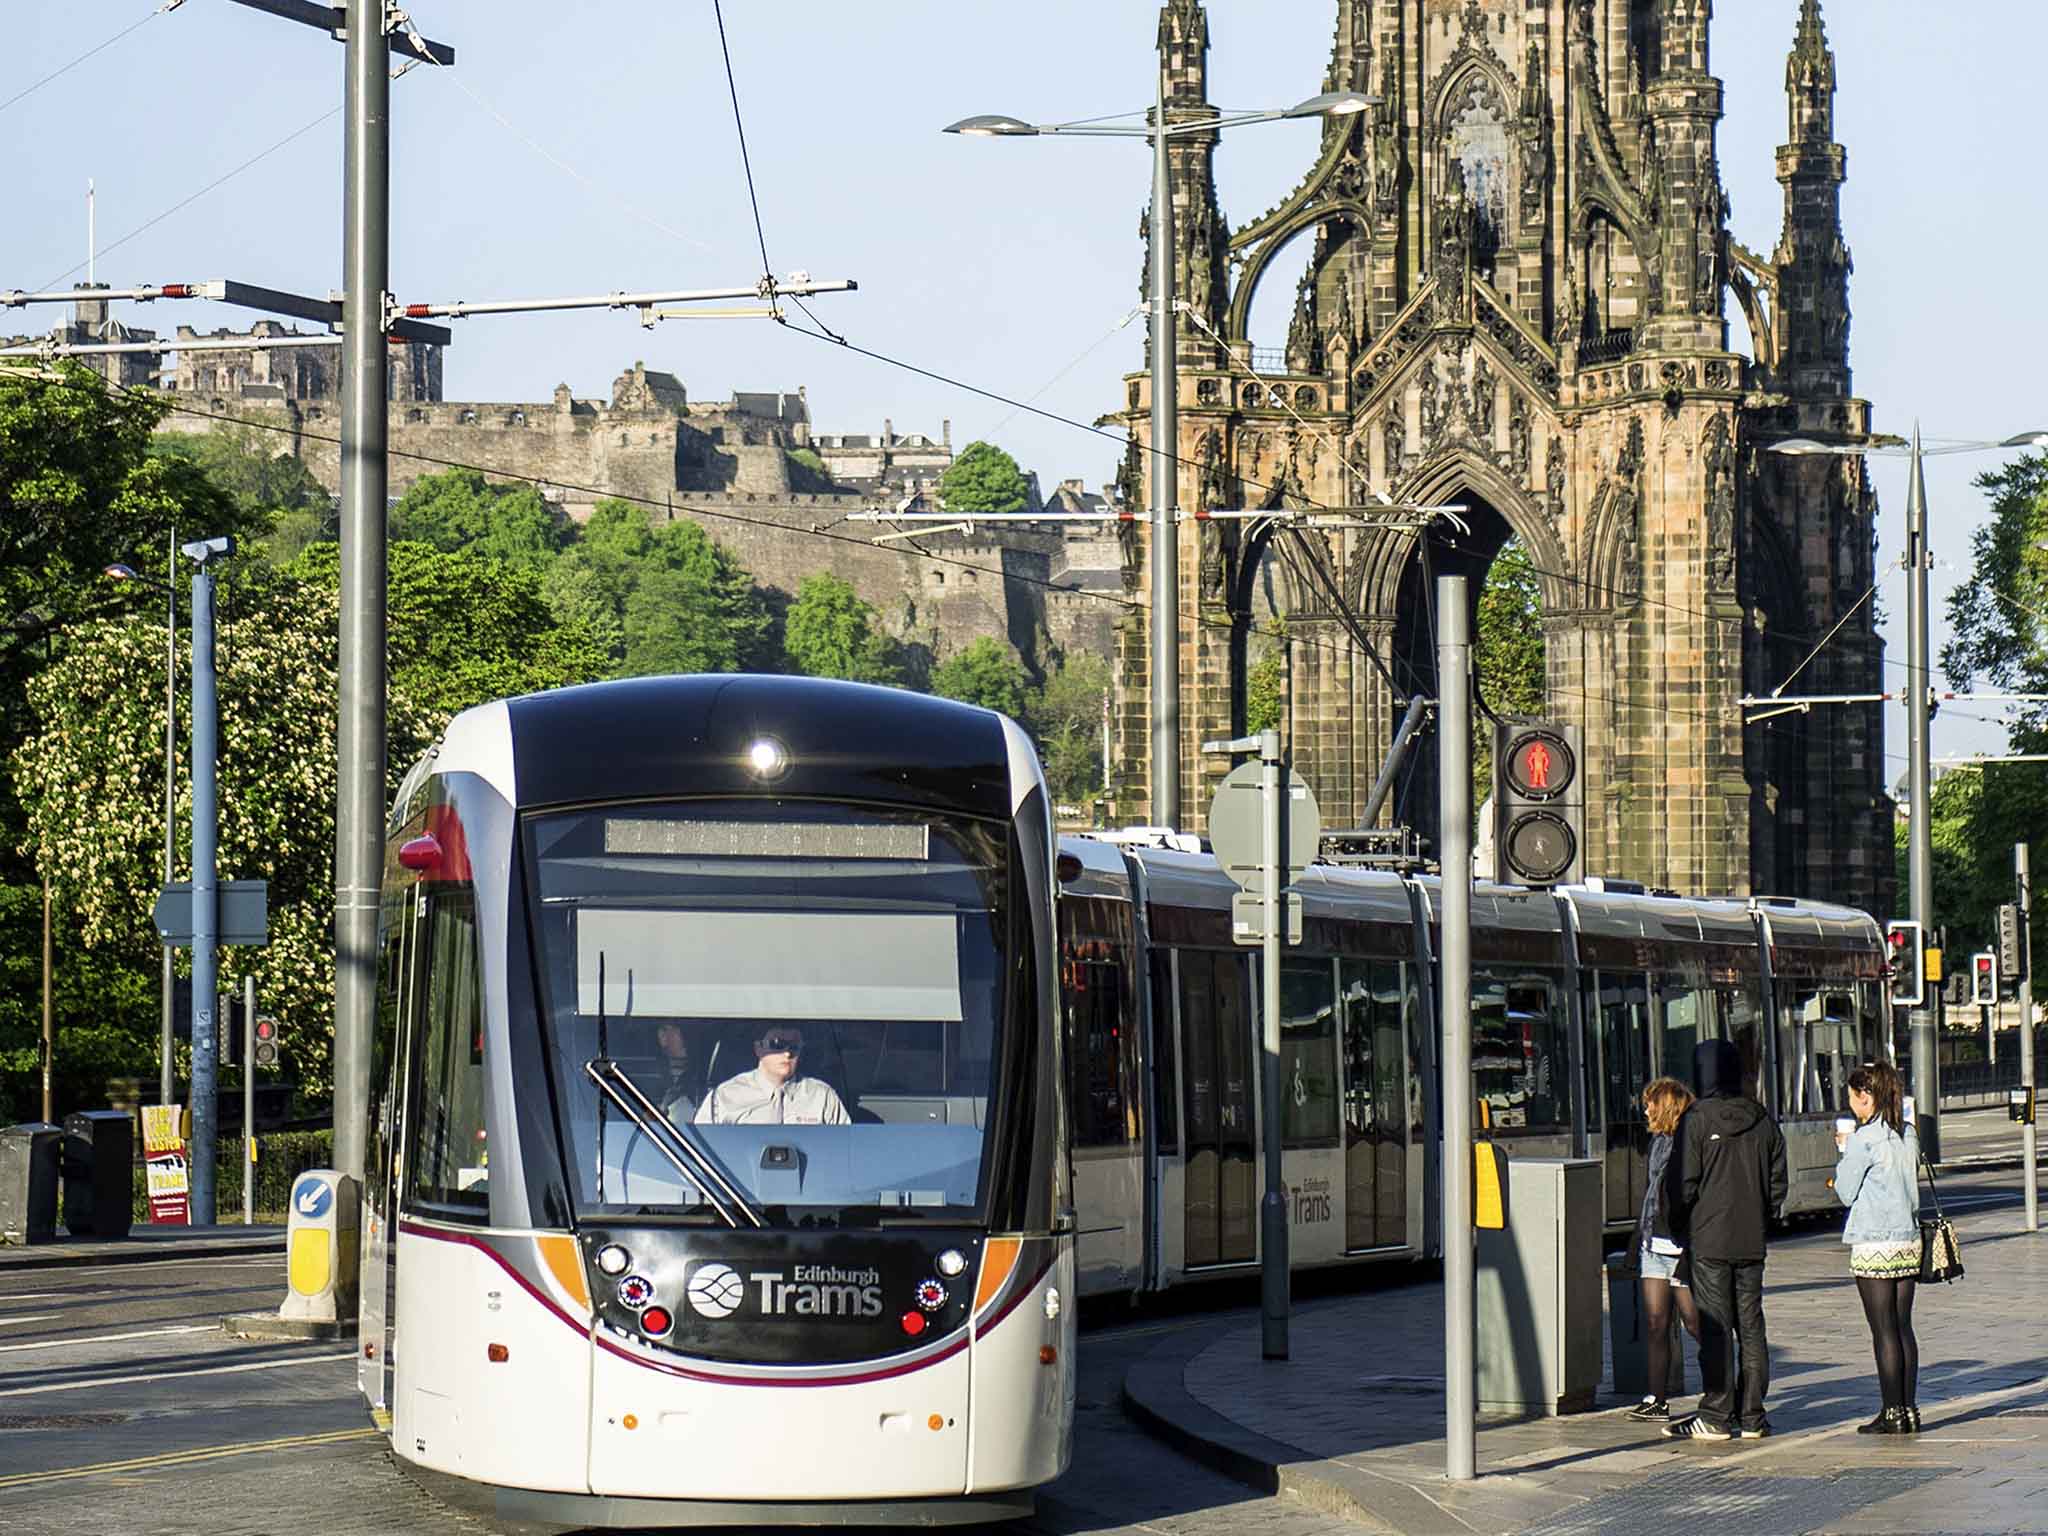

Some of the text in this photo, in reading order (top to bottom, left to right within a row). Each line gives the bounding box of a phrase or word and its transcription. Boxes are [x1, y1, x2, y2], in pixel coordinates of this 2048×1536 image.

[1291, 1186, 1330, 1225] Trams
[750, 1272, 882, 1316] Trams
[794, 1265, 879, 1286] Edinburgh
